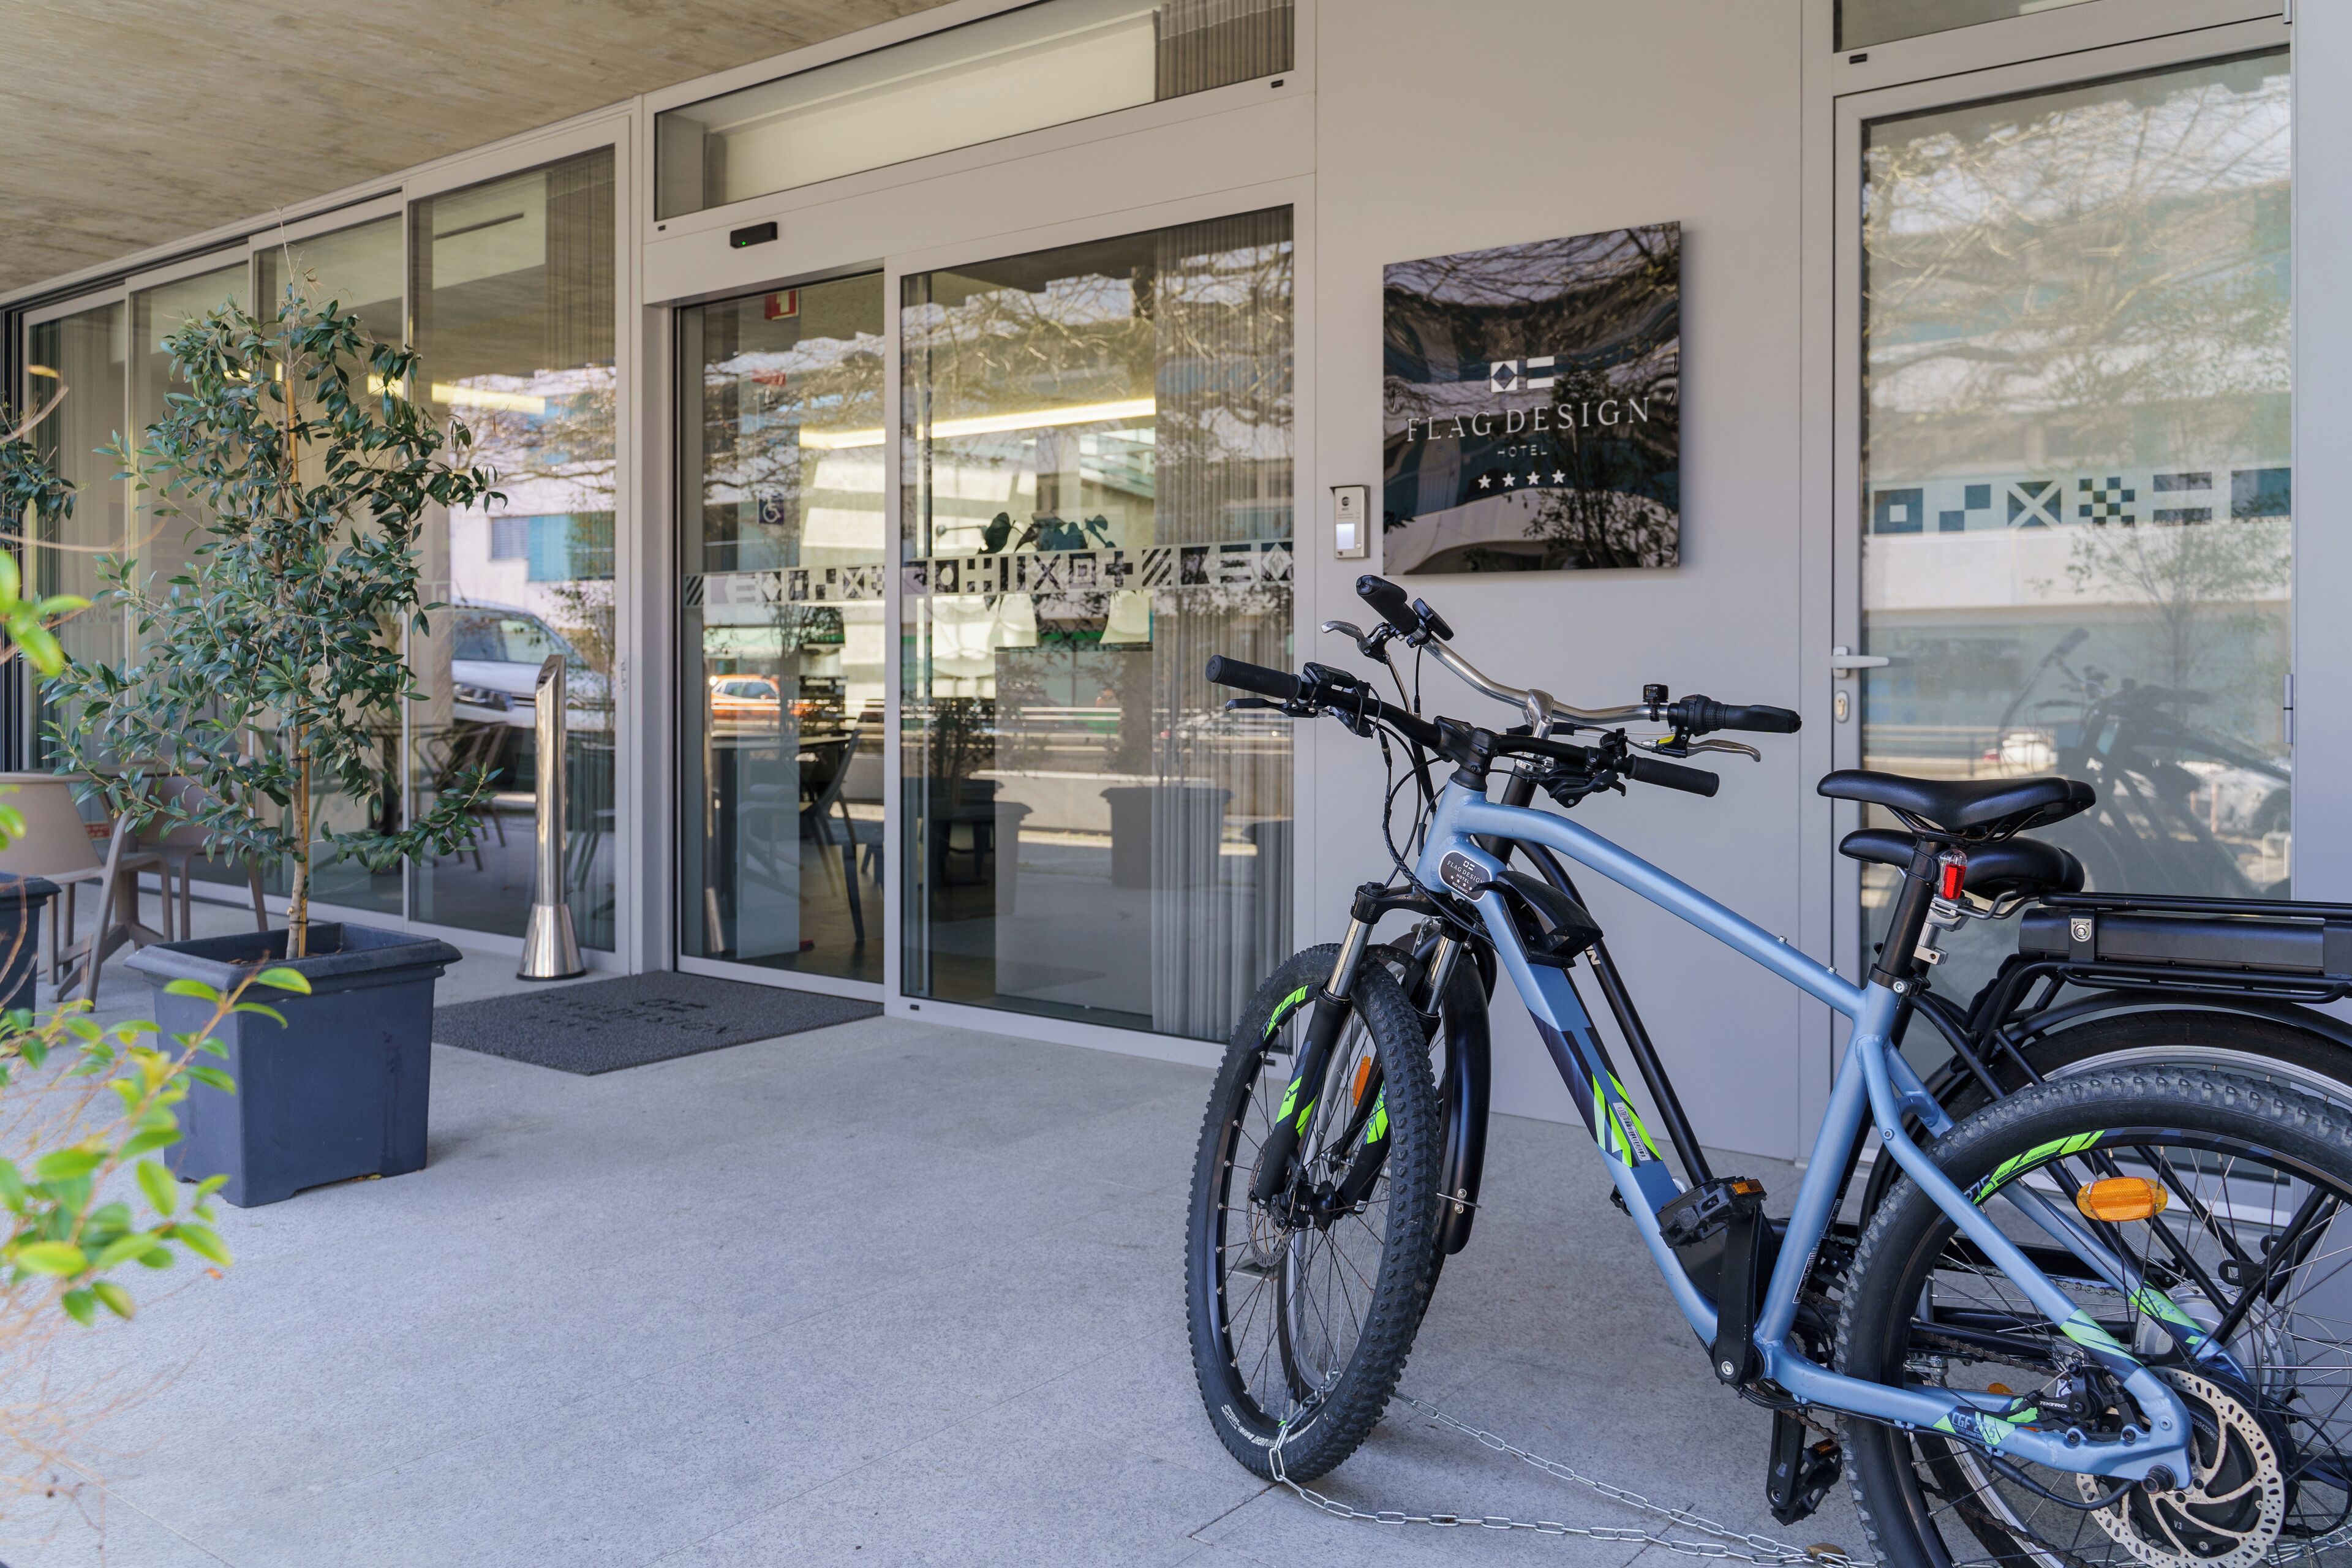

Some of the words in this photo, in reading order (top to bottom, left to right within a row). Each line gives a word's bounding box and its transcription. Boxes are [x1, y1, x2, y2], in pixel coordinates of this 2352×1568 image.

[1407, 410, 1491, 442] FLAG
[1506, 397, 1649, 434] DESIGN
[1497, 445, 1548, 458] HOTEL
[1447, 860, 1462, 872] FLAG
[1456, 873, 1469, 884] HOTEL
[1951, 1411, 1972, 1429] CGF
[2174, 1520, 2182, 1530] V3
